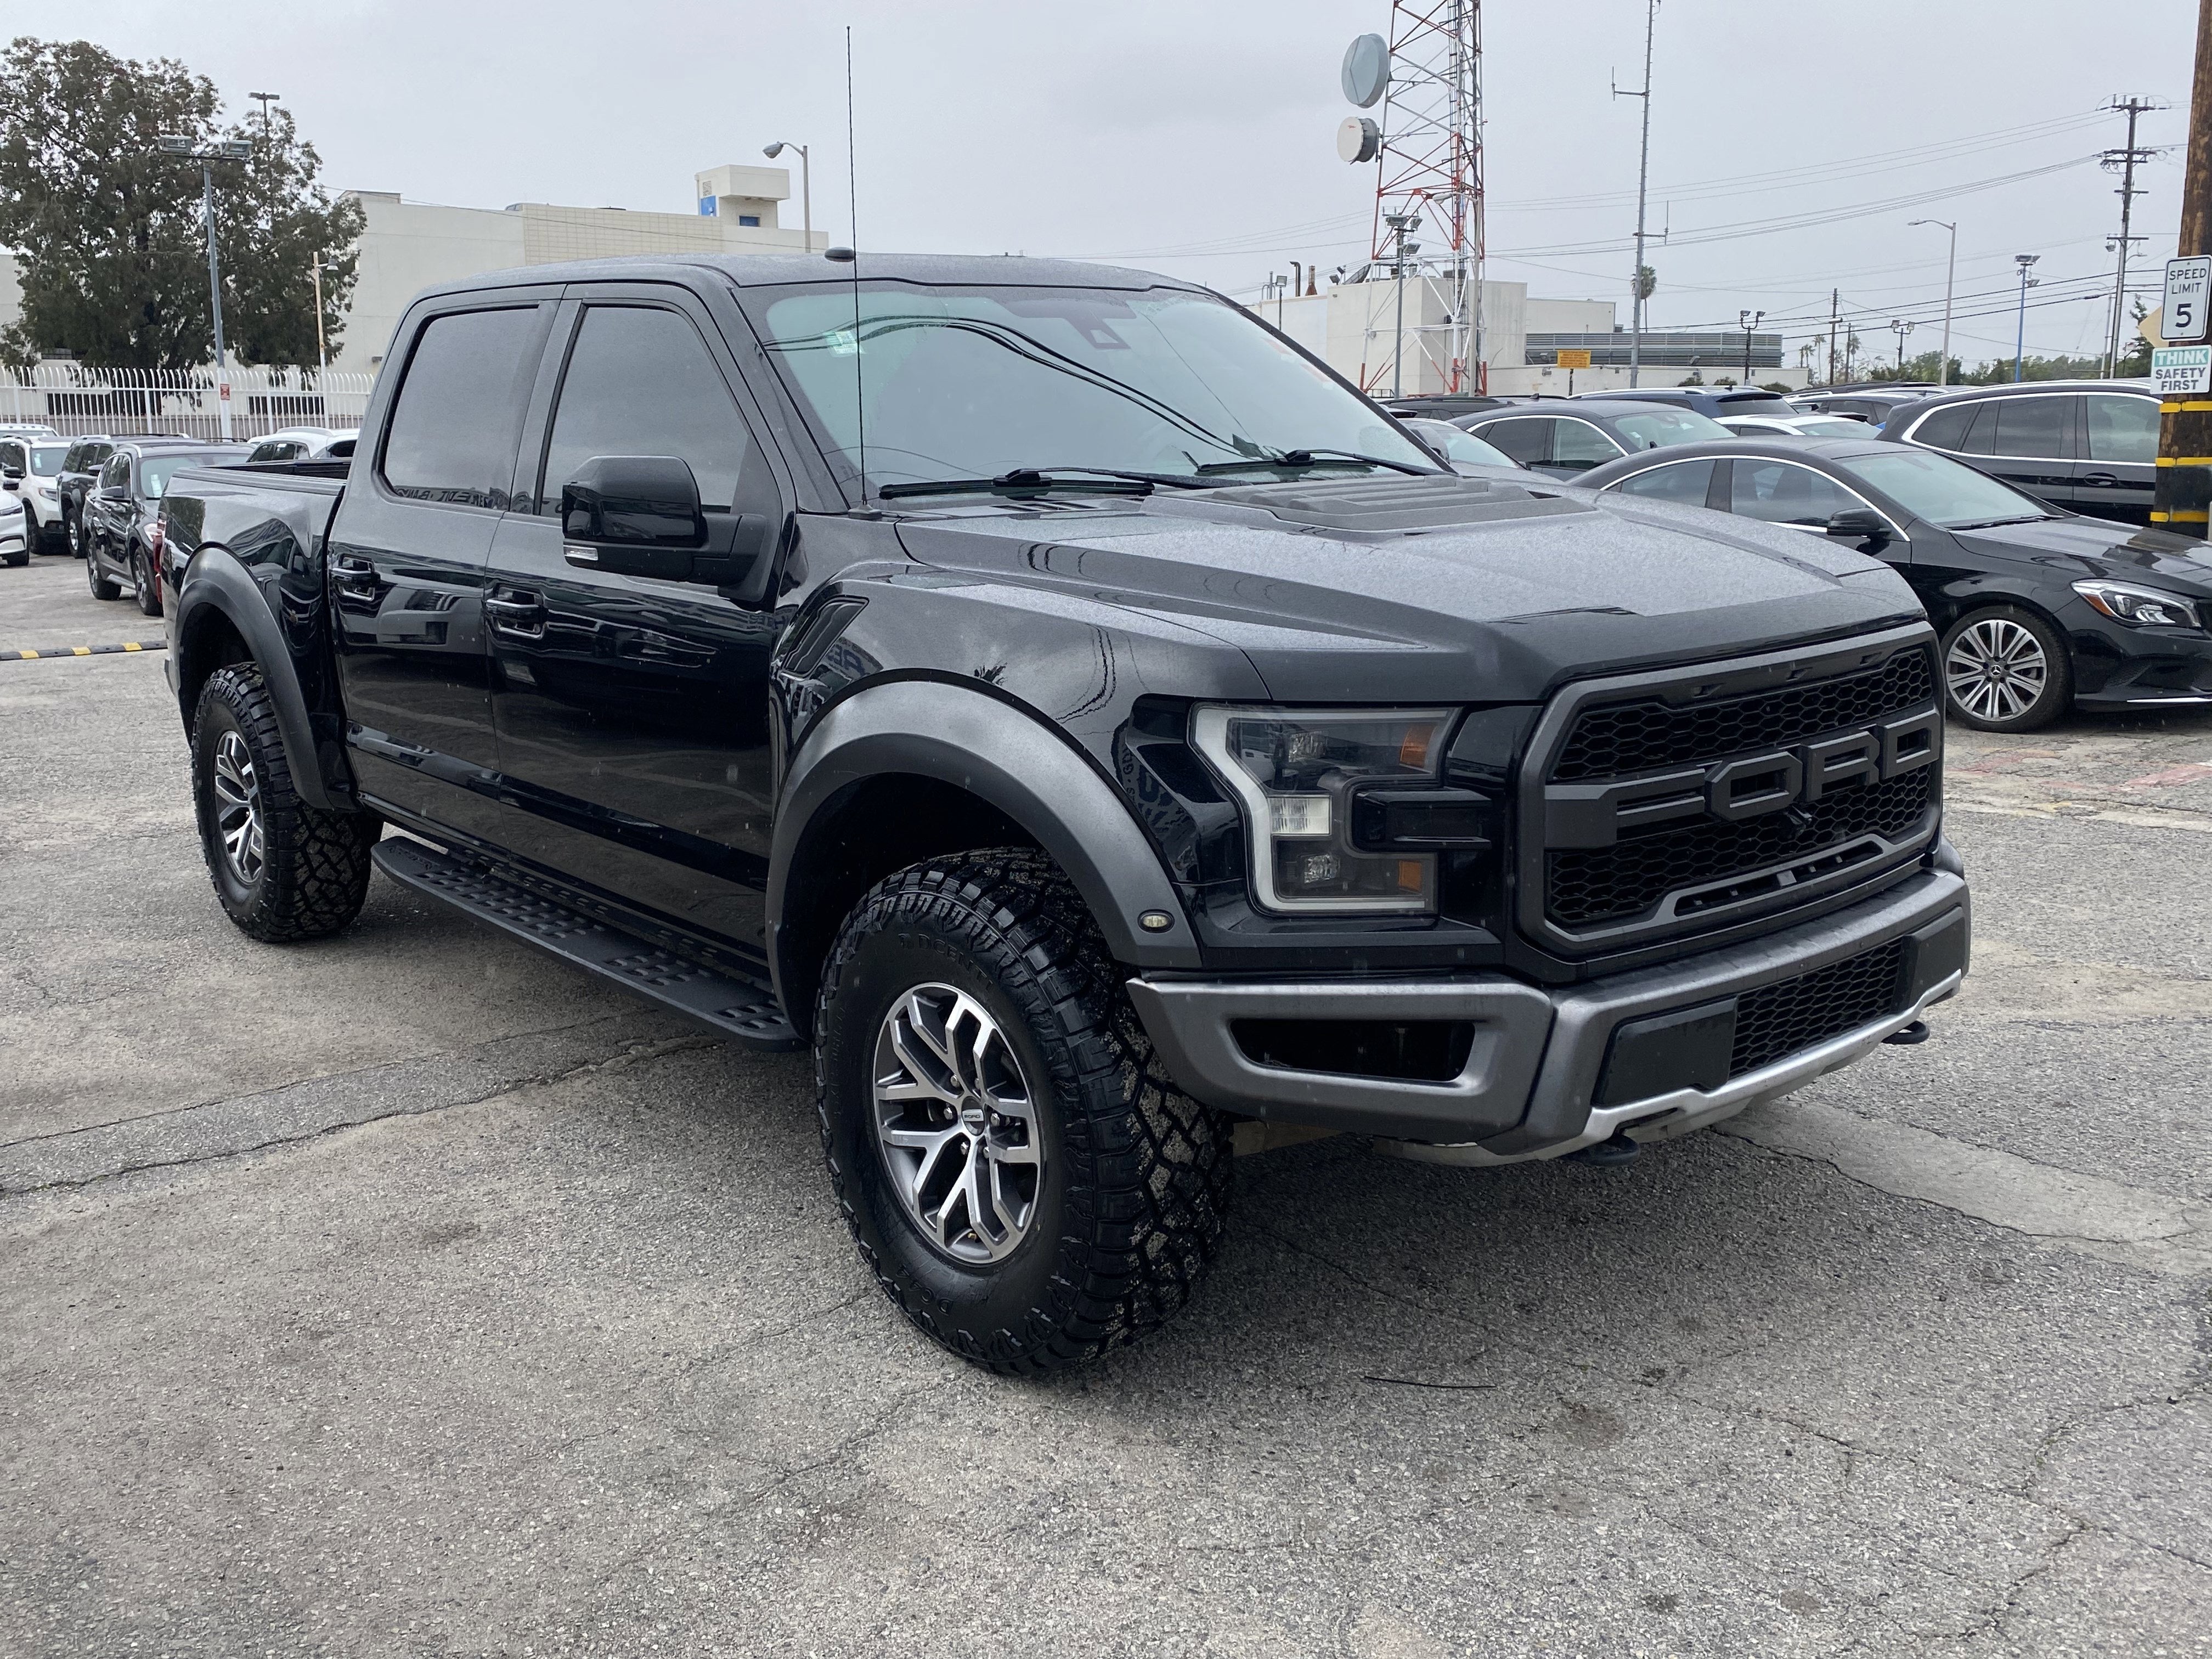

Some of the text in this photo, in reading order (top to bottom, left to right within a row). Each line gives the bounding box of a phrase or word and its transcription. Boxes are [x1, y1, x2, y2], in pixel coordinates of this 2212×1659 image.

[2169, 268, 2207, 280] SPEED
[2171, 283, 2202, 294] LIMIT
[2175, 303, 2192, 328] 5
[2156, 350, 2207, 366] THINK
[2155, 367, 2206, 380] SAFETY
[2160, 379, 2199, 391] FIRST
[1545, 710, 1940, 849] FORD
